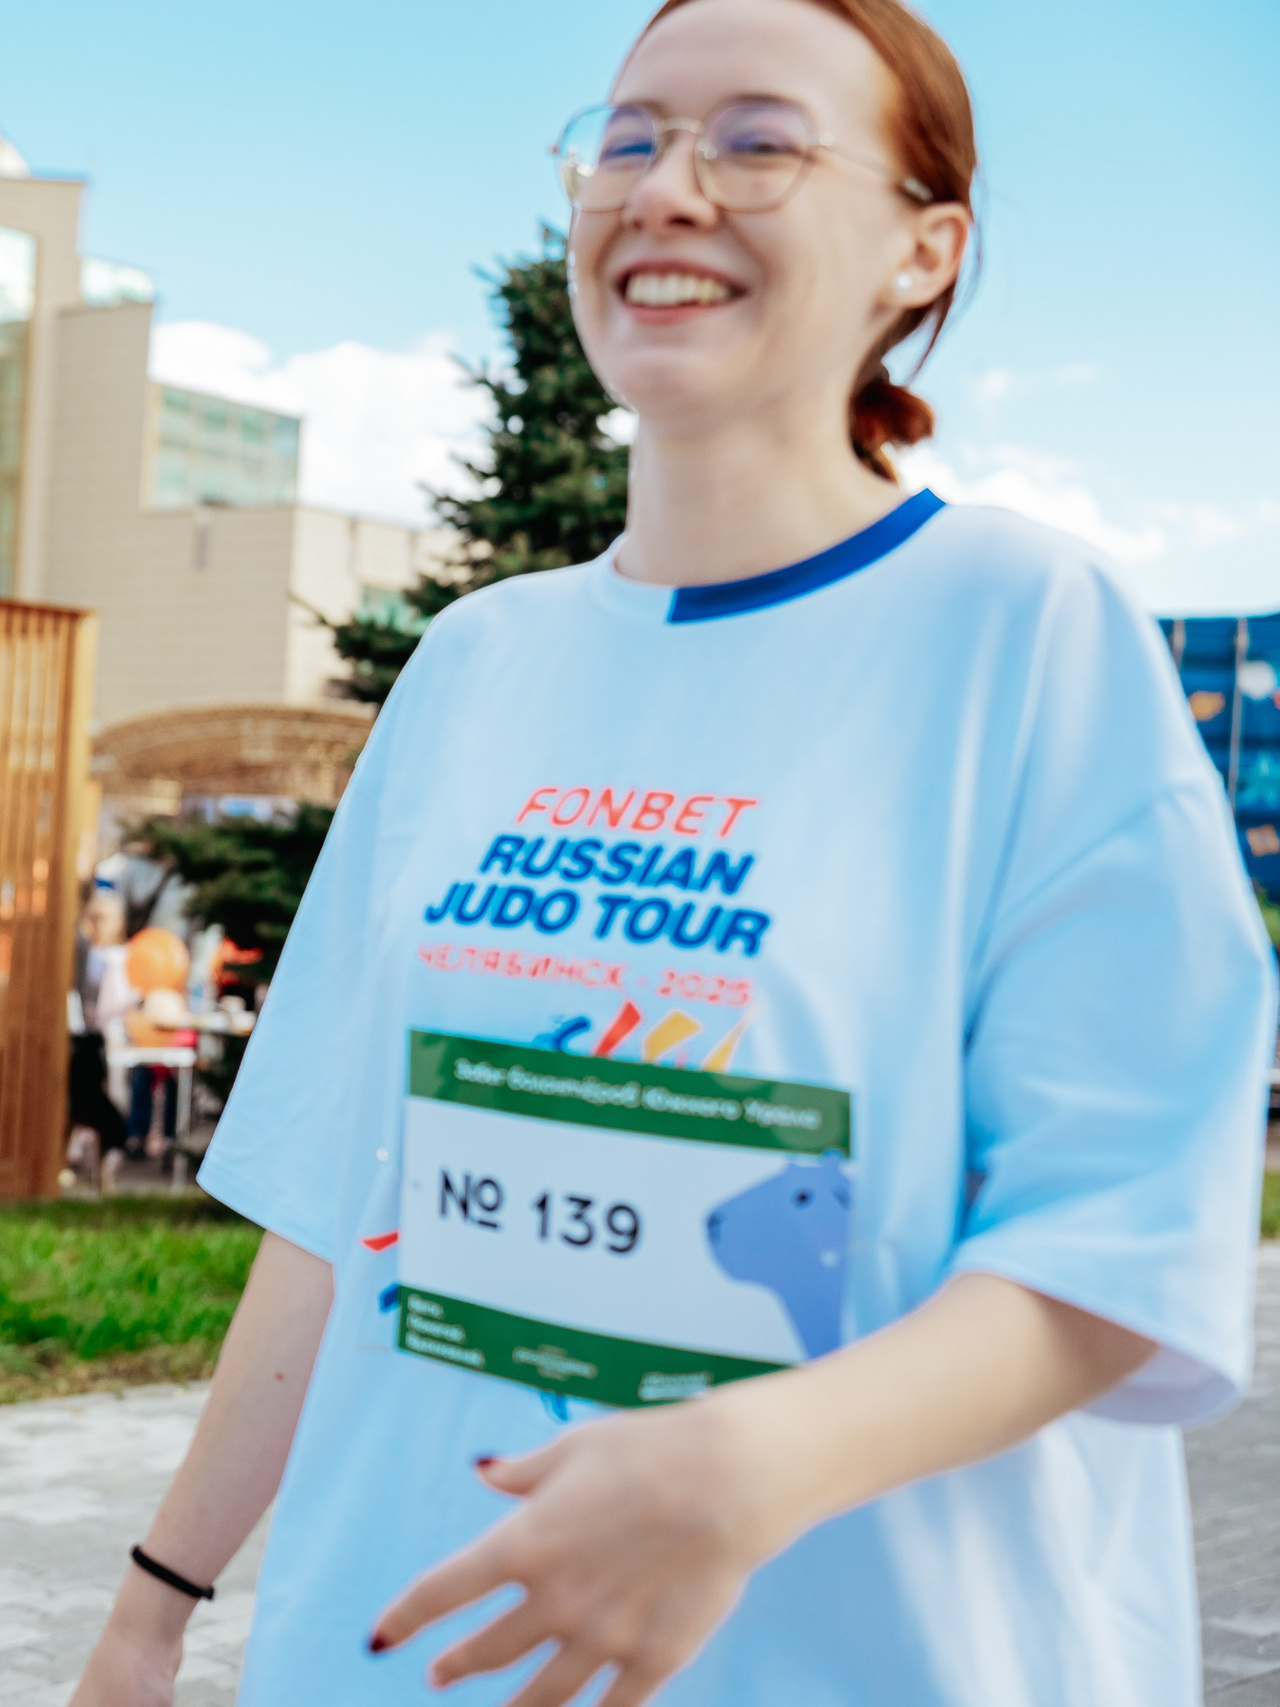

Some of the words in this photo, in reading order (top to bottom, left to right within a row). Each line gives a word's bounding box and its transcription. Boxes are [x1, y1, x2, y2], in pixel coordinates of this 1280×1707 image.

[516, 786, 759, 838] FONBET
[479, 834, 754, 896] RUSSIAN
[425, 882, 581, 934] JUDO
[595, 894, 771, 956] TOUR
[419, 945, 623, 989] ЧЕЛЯБИНСК
[657, 969, 751, 1006] 2025
[440, 1171, 501, 1231] №
[534, 1192, 641, 1255] 139
